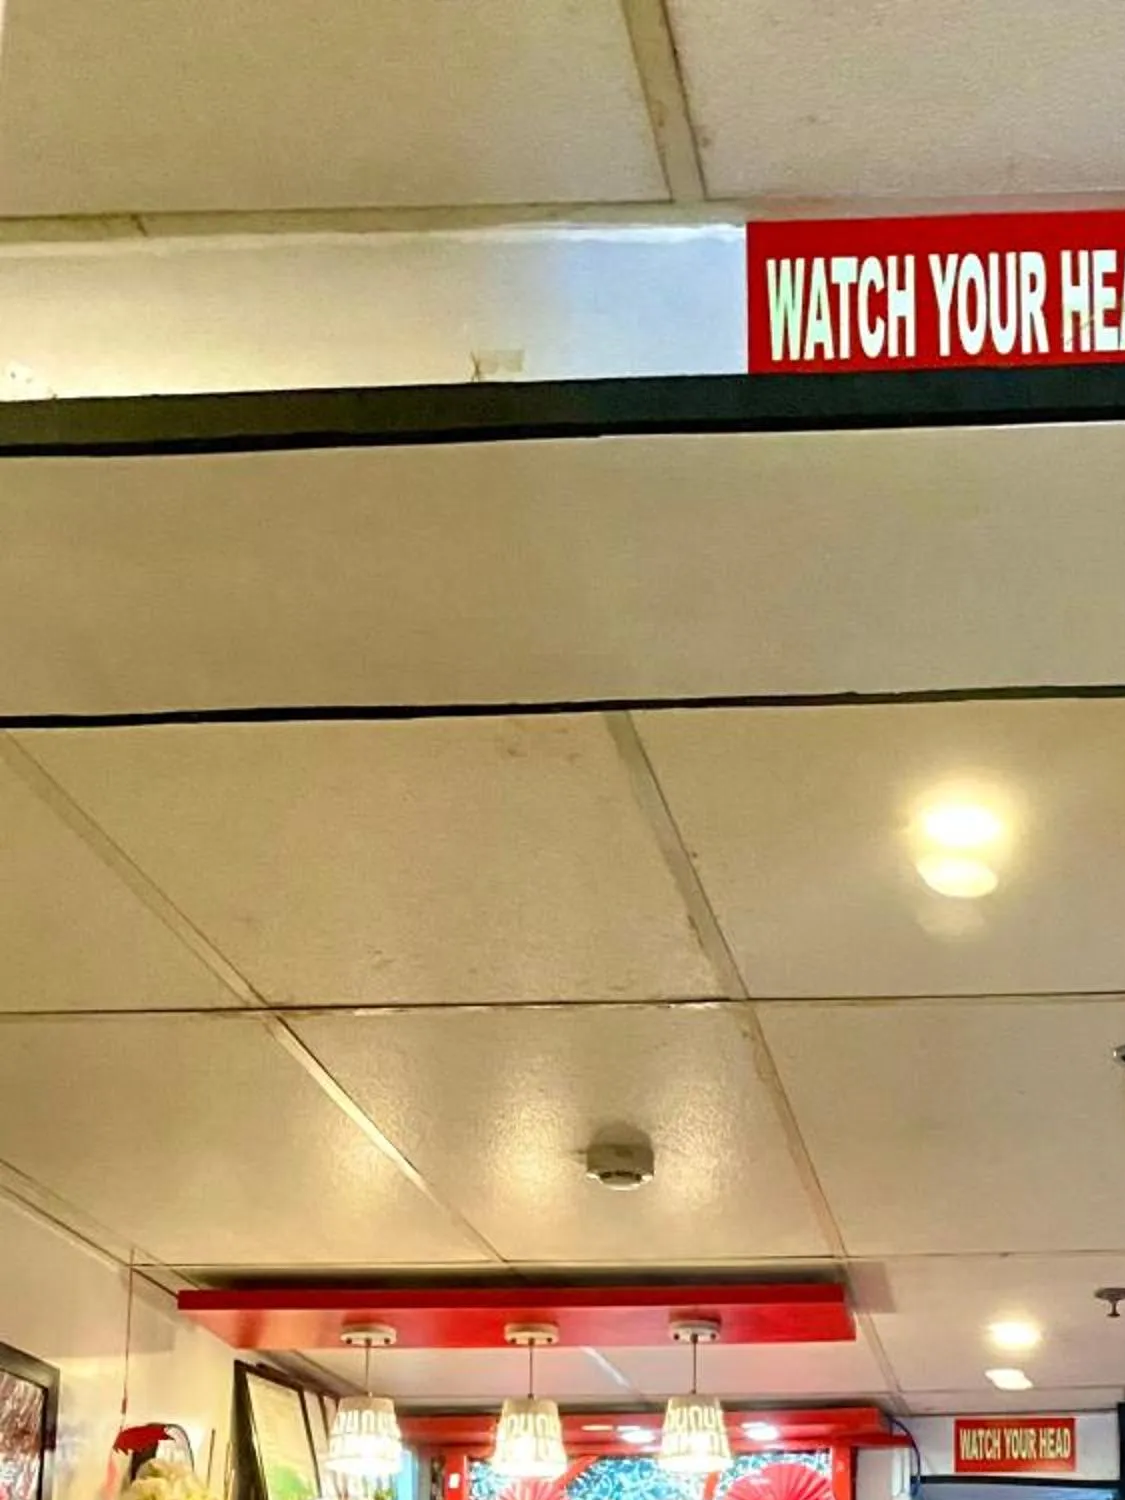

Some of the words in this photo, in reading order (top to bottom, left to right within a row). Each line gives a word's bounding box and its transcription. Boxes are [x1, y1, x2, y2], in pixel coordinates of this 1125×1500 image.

[766, 255, 915, 361] WATCH
[928, 250, 1048, 358] YOUR
[960, 1427, 1001, 1460] WATCH
[1003, 1427, 1037, 1460] YOUR
[1039, 1427, 1071, 1459] HEAD
